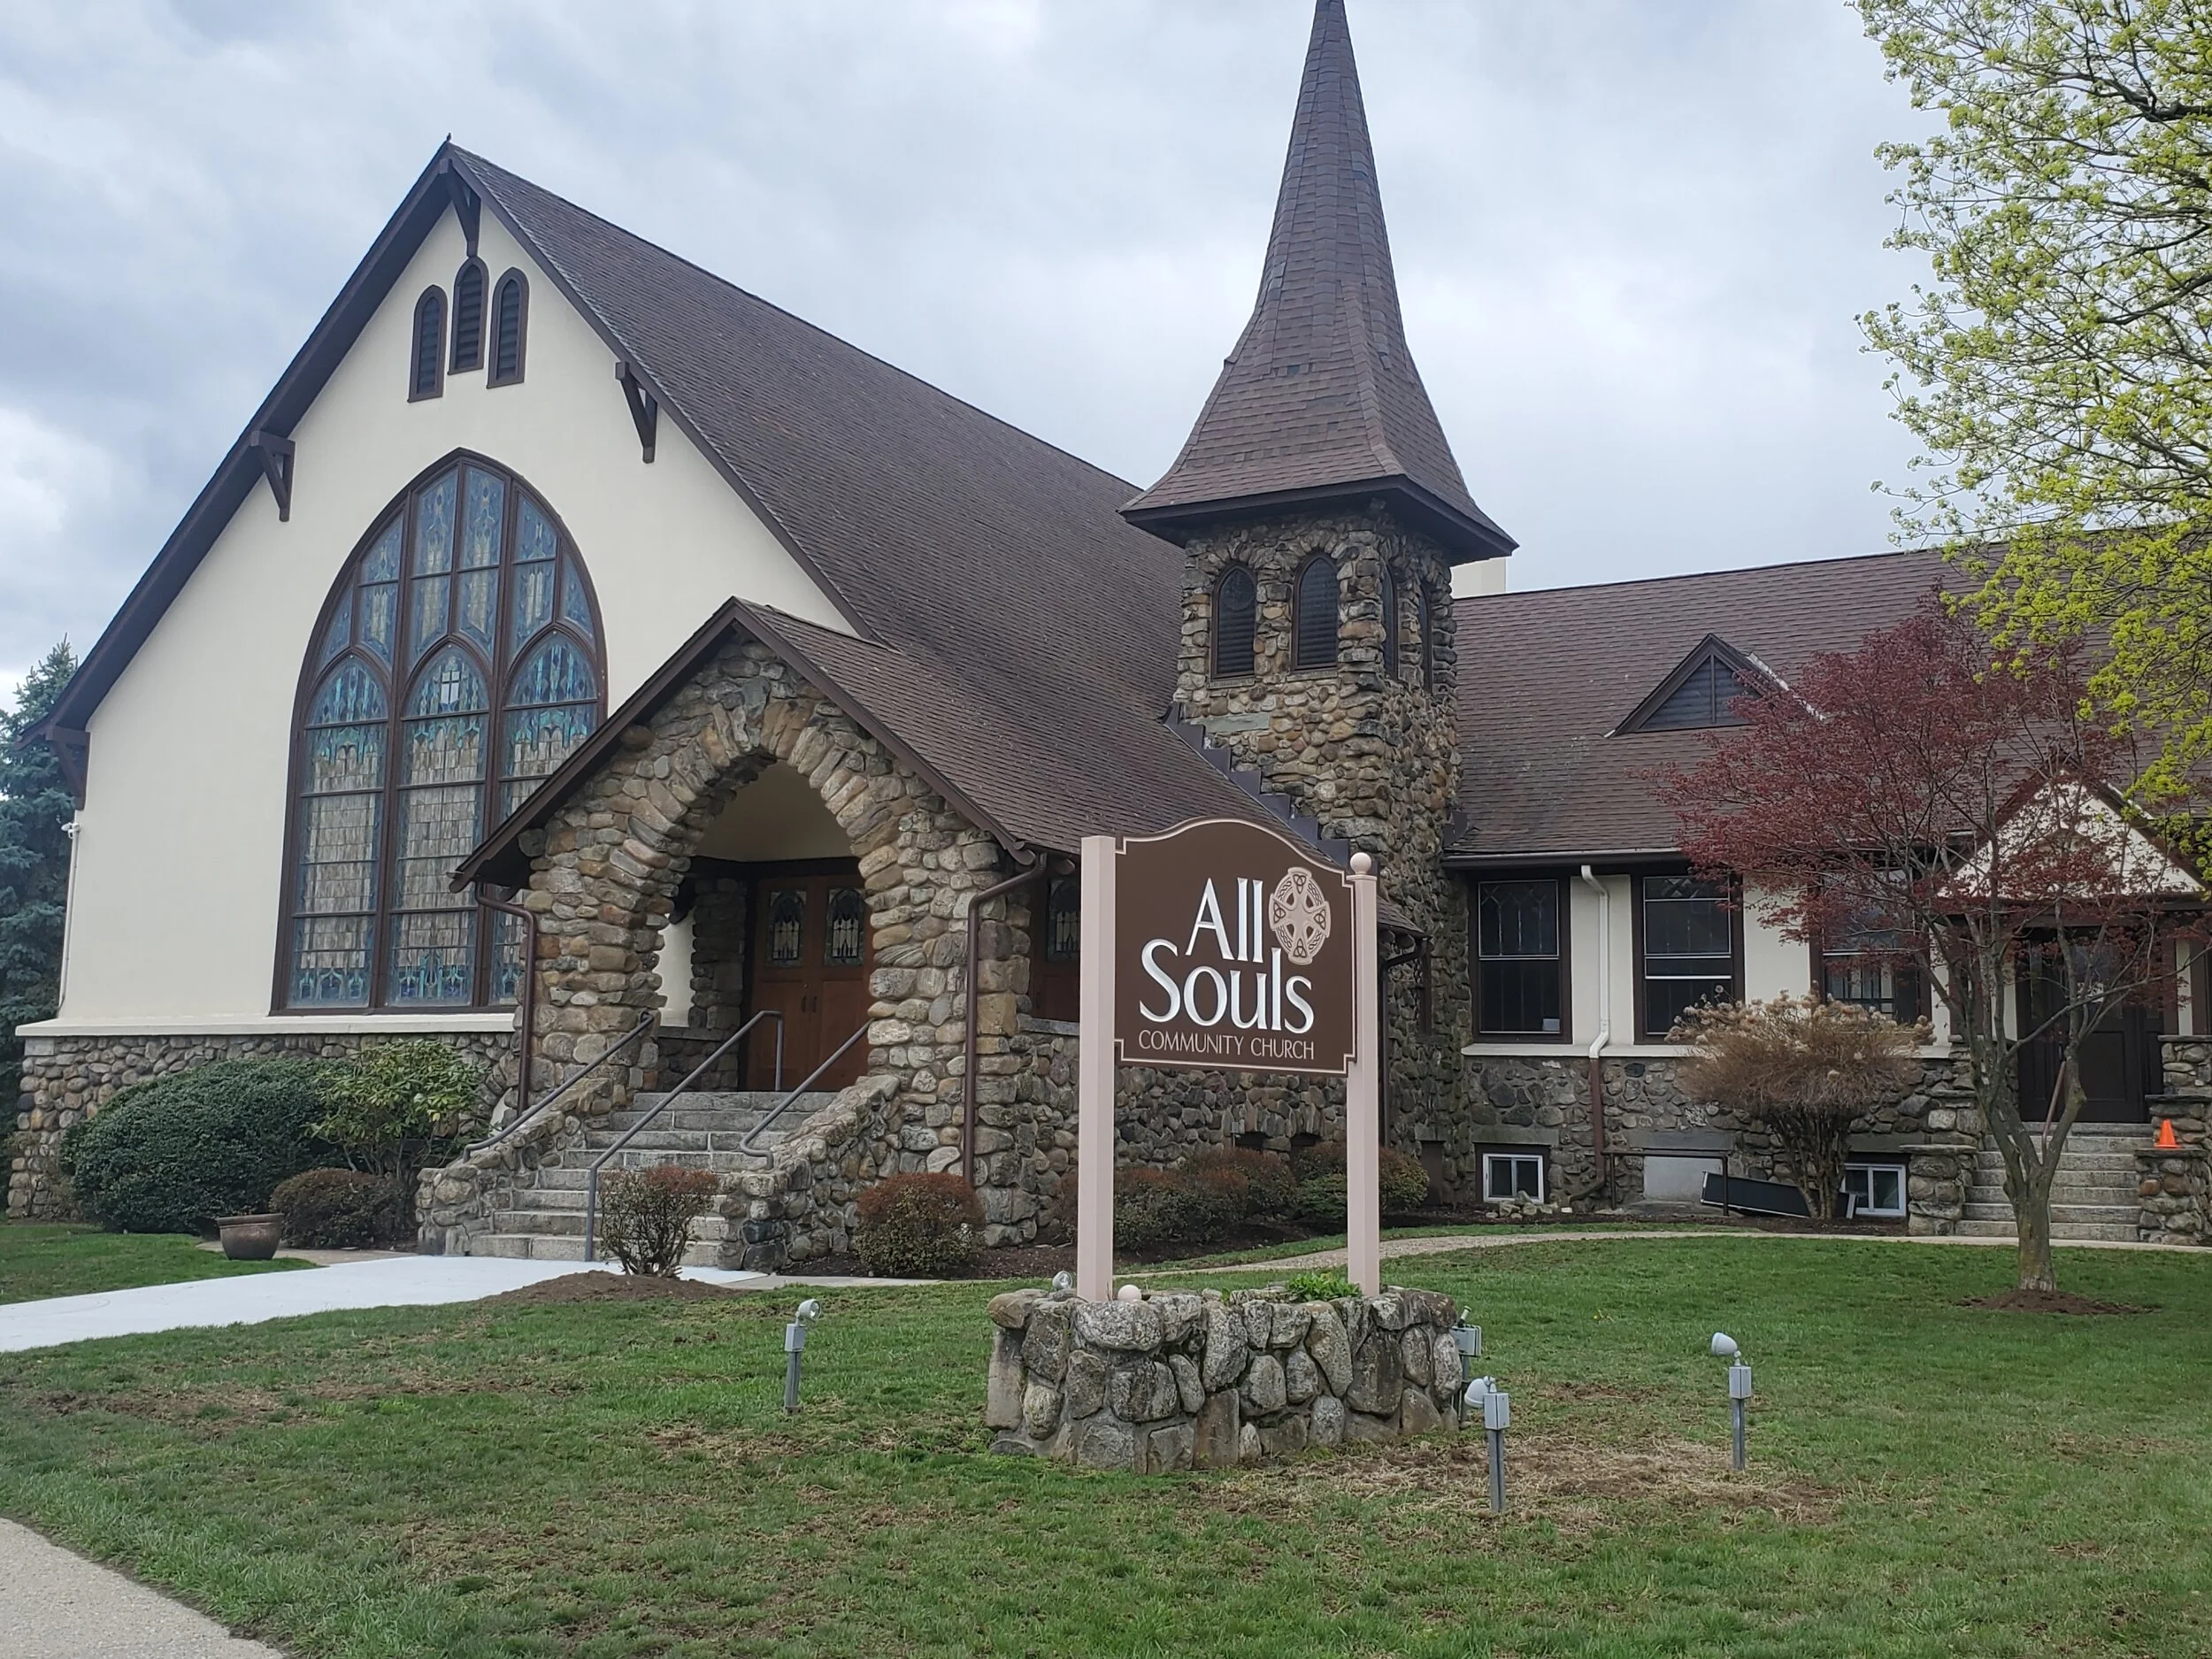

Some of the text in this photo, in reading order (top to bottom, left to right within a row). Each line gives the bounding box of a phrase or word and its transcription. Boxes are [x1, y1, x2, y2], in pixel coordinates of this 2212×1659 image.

[1186, 878, 1263, 964] All
[1139, 939, 1315, 1034] Souls
[1139, 1029, 1315, 1060] COMMUNITY CHURCH
